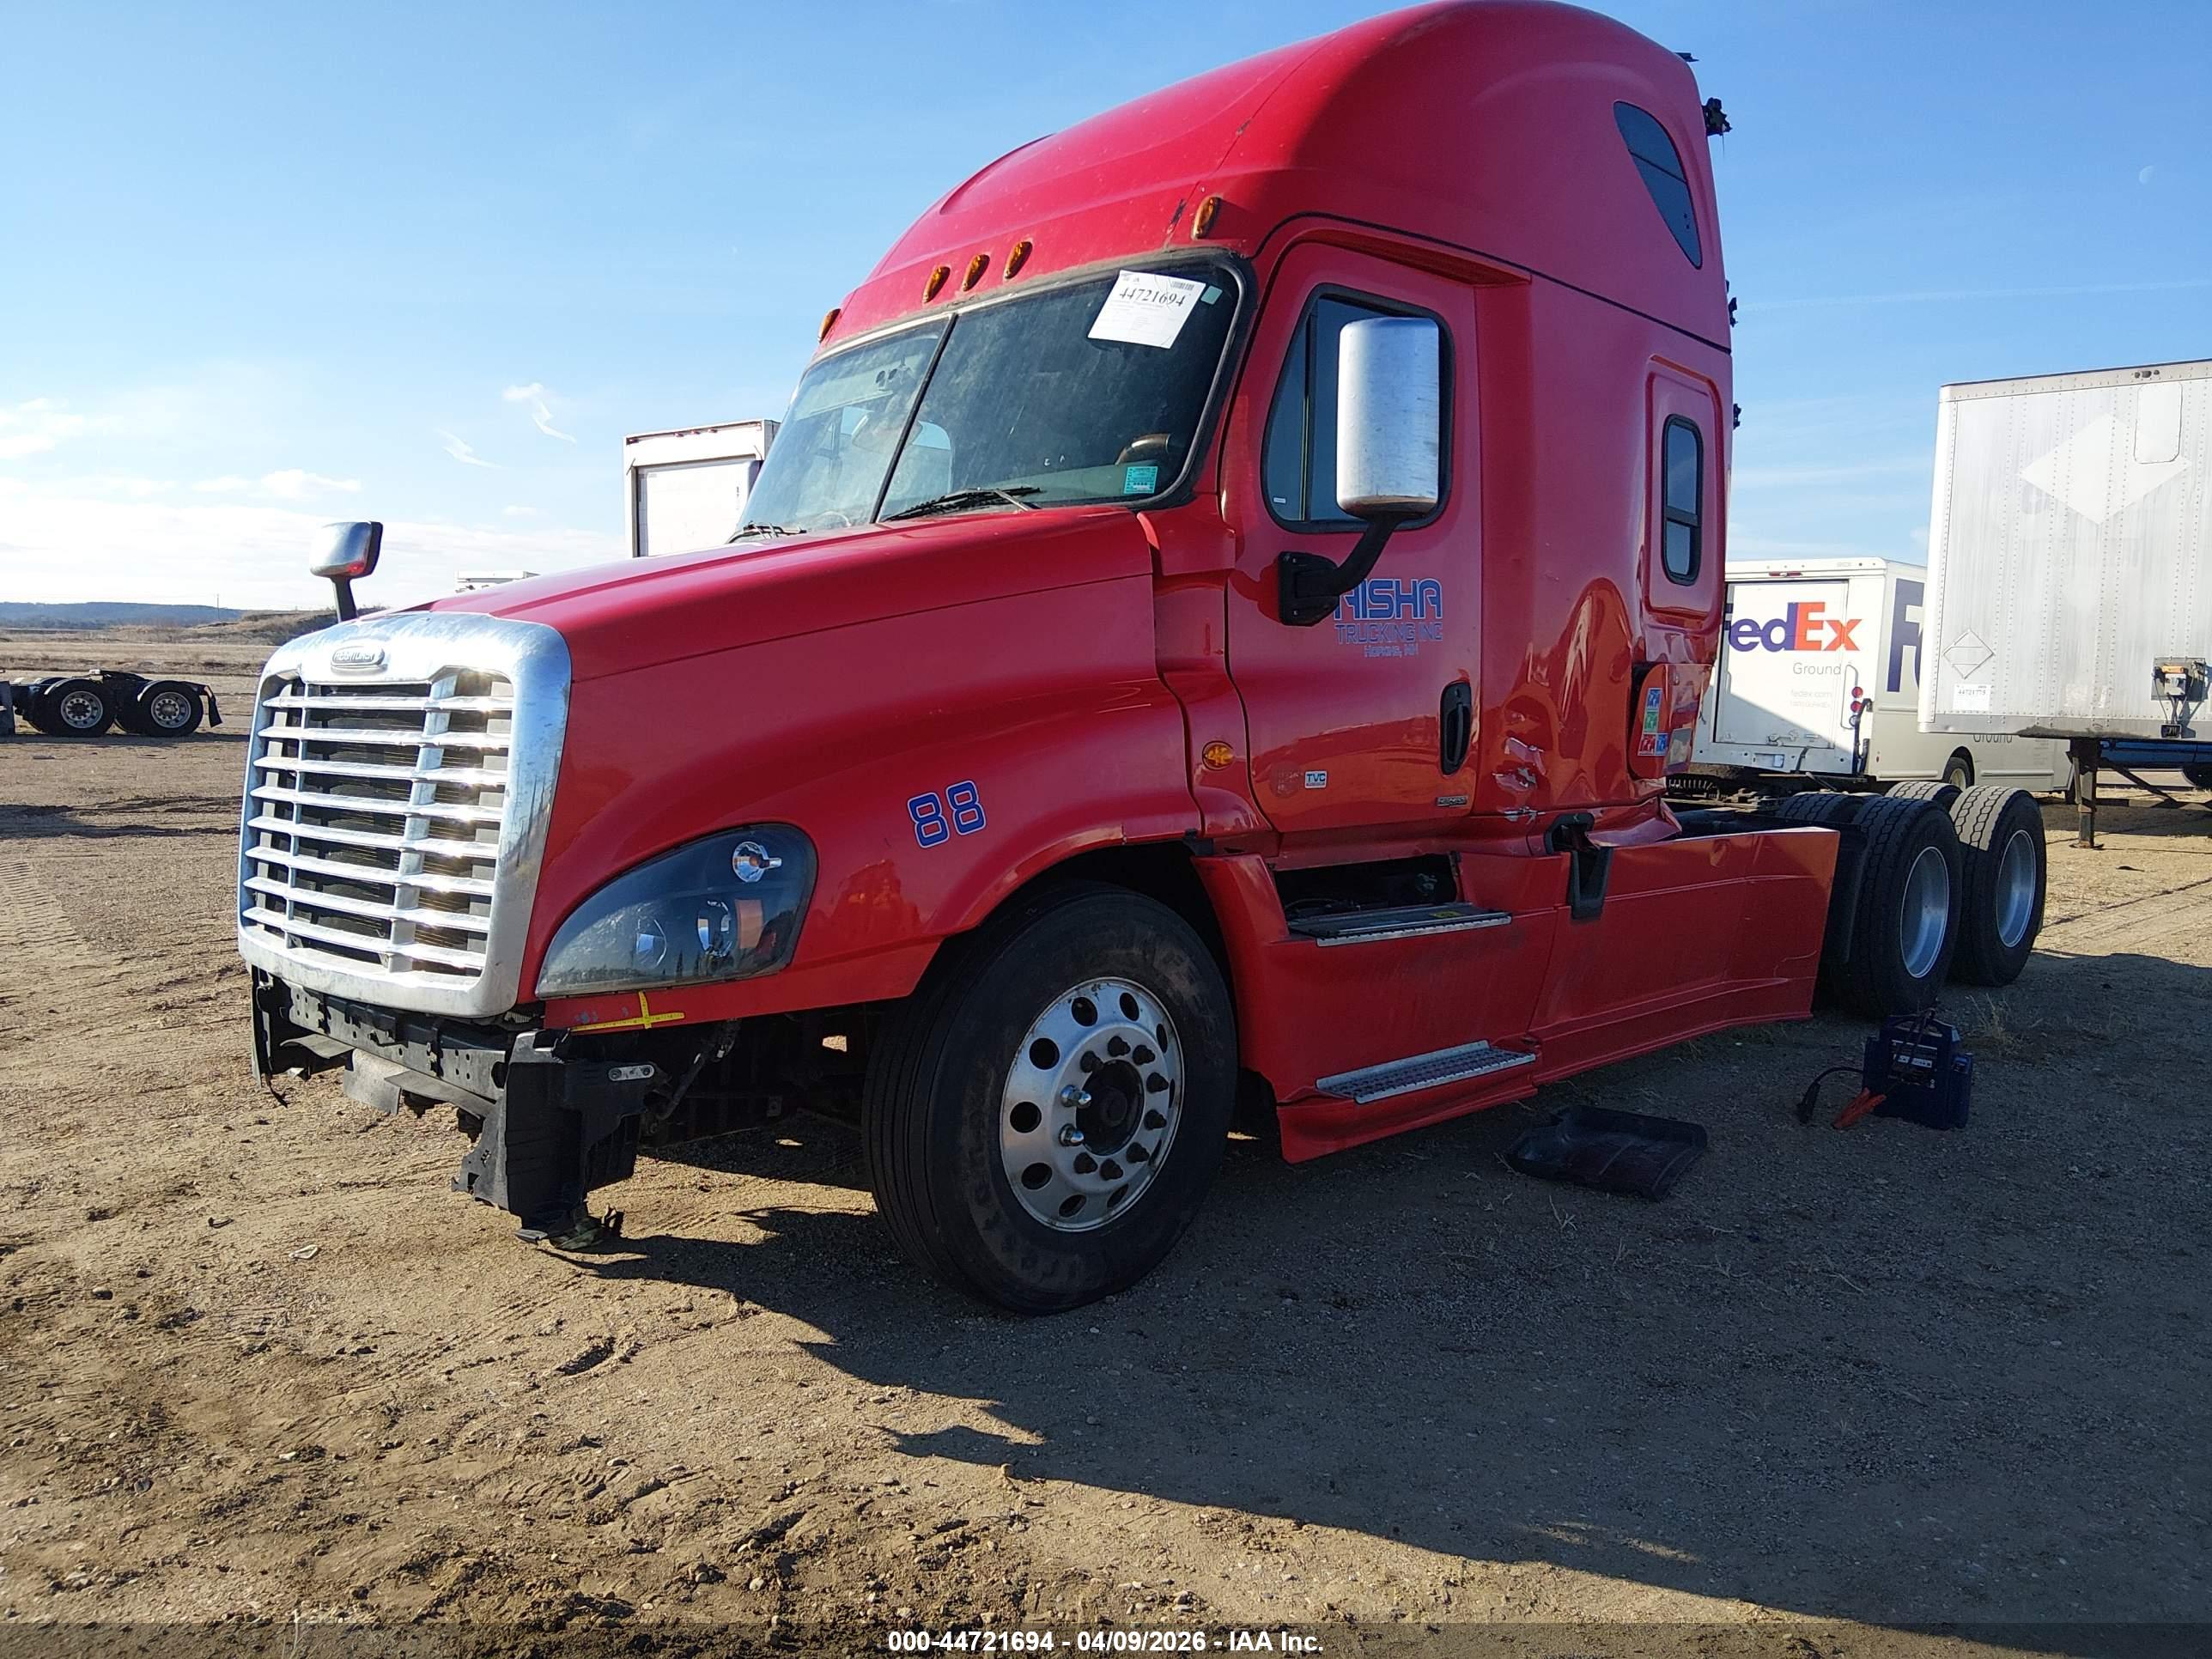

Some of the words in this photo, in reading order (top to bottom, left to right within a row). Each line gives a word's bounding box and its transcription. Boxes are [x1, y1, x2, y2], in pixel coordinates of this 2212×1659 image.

[1119, 287, 1187, 307] 44721694
[1334, 623, 1415, 644] TRUCKING
[1418, 622, 1443, 642] INC
[1724, 602, 1863, 652] edEx
[1793, 662, 1842, 675] Ground
[907, 780, 987, 848] 88
